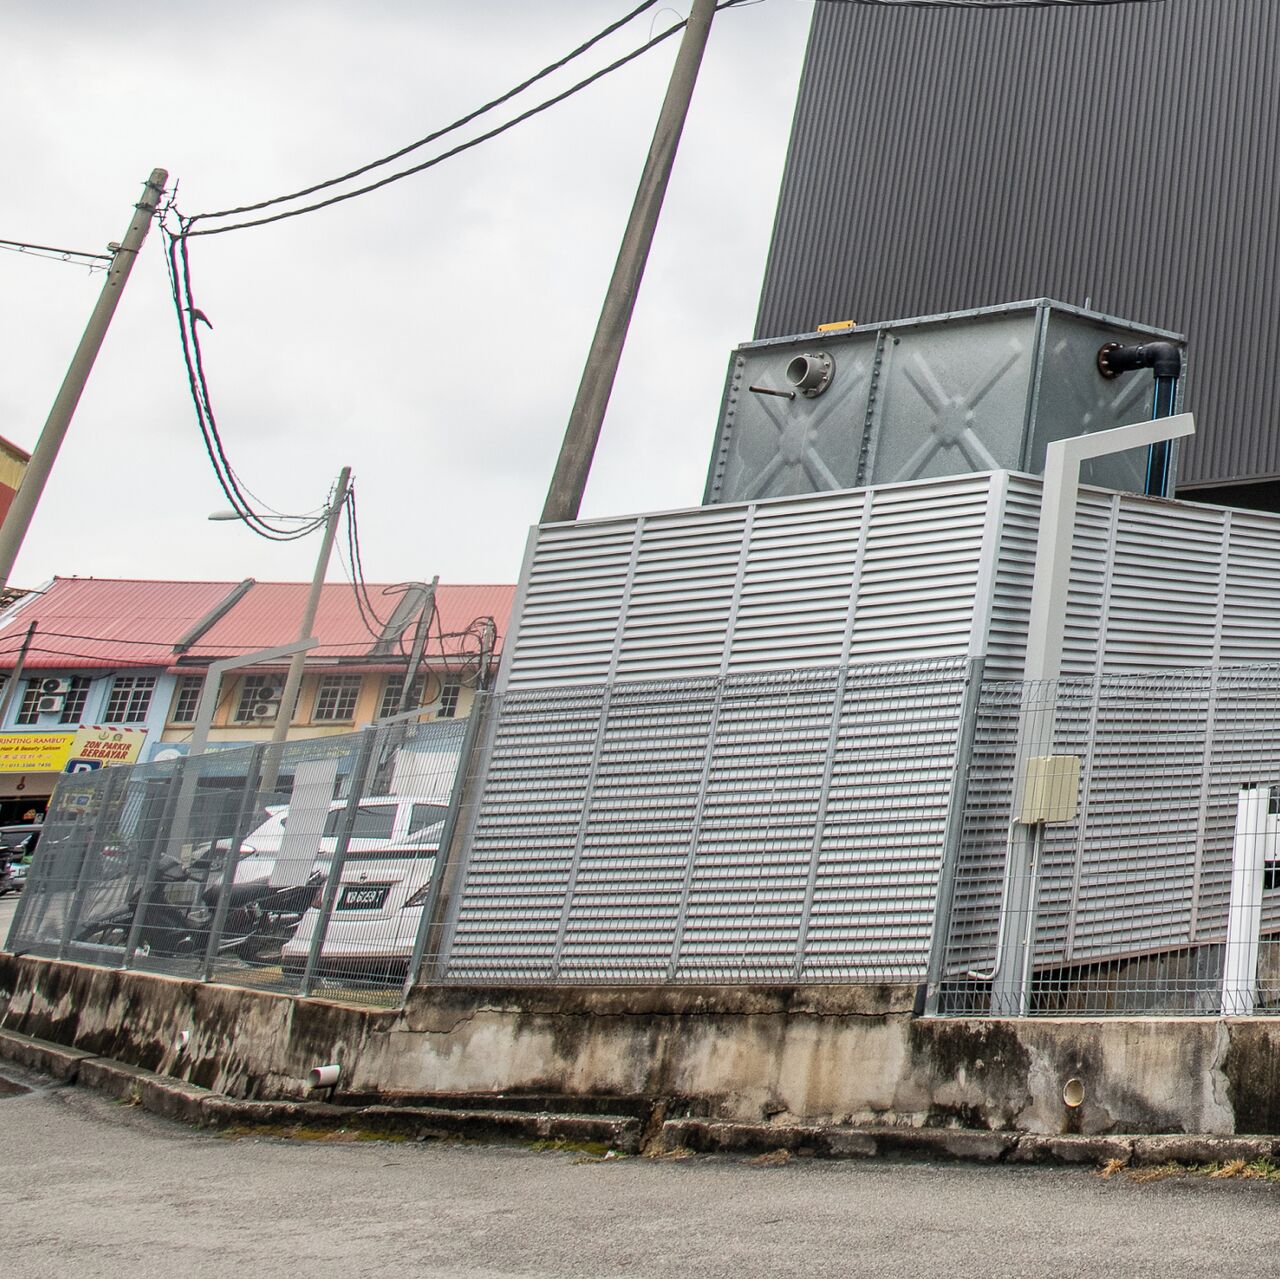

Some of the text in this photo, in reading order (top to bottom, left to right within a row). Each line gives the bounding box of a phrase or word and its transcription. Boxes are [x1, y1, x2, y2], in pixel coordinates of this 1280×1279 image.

[84, 741, 132, 750] ZON PARKIR
[80, 748, 128, 759] BERBAYAR
